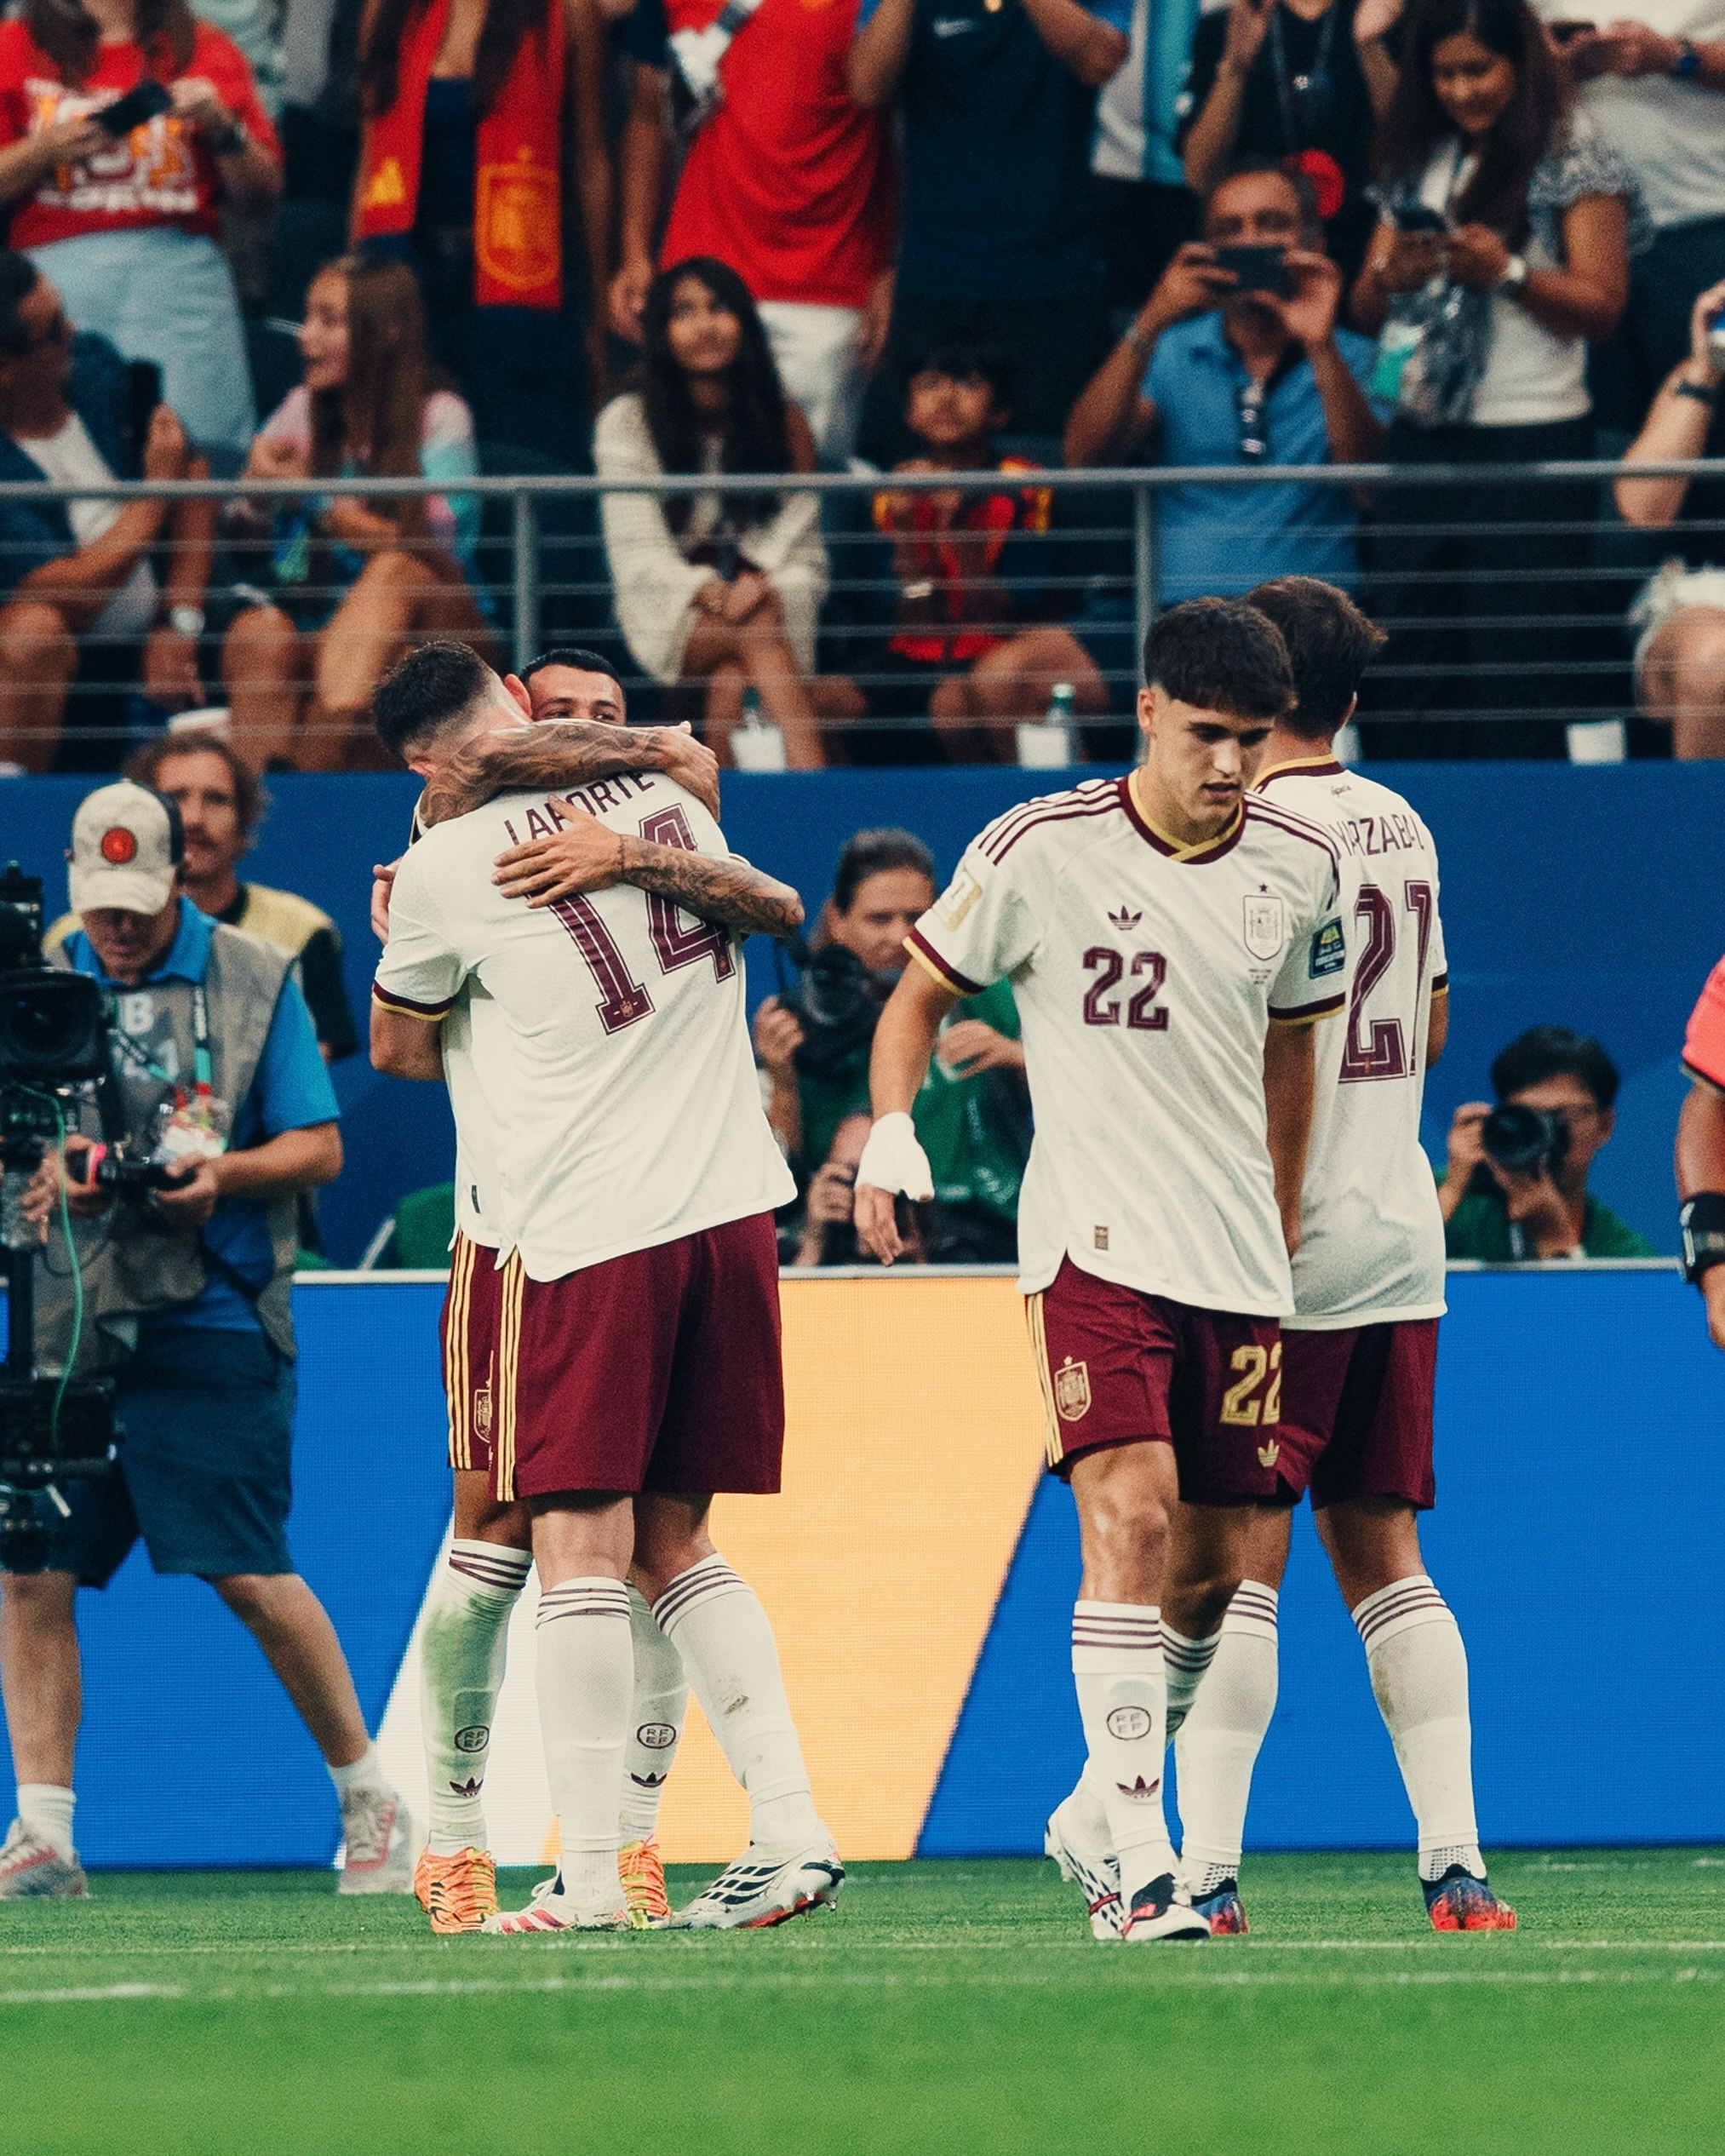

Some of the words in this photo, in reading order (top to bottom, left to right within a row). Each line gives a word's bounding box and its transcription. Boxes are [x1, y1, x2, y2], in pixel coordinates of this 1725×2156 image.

[524, 803, 736, 1035] 14
[1082, 945, 1169, 1031] 22
[1338, 880, 1432, 1084] 21
